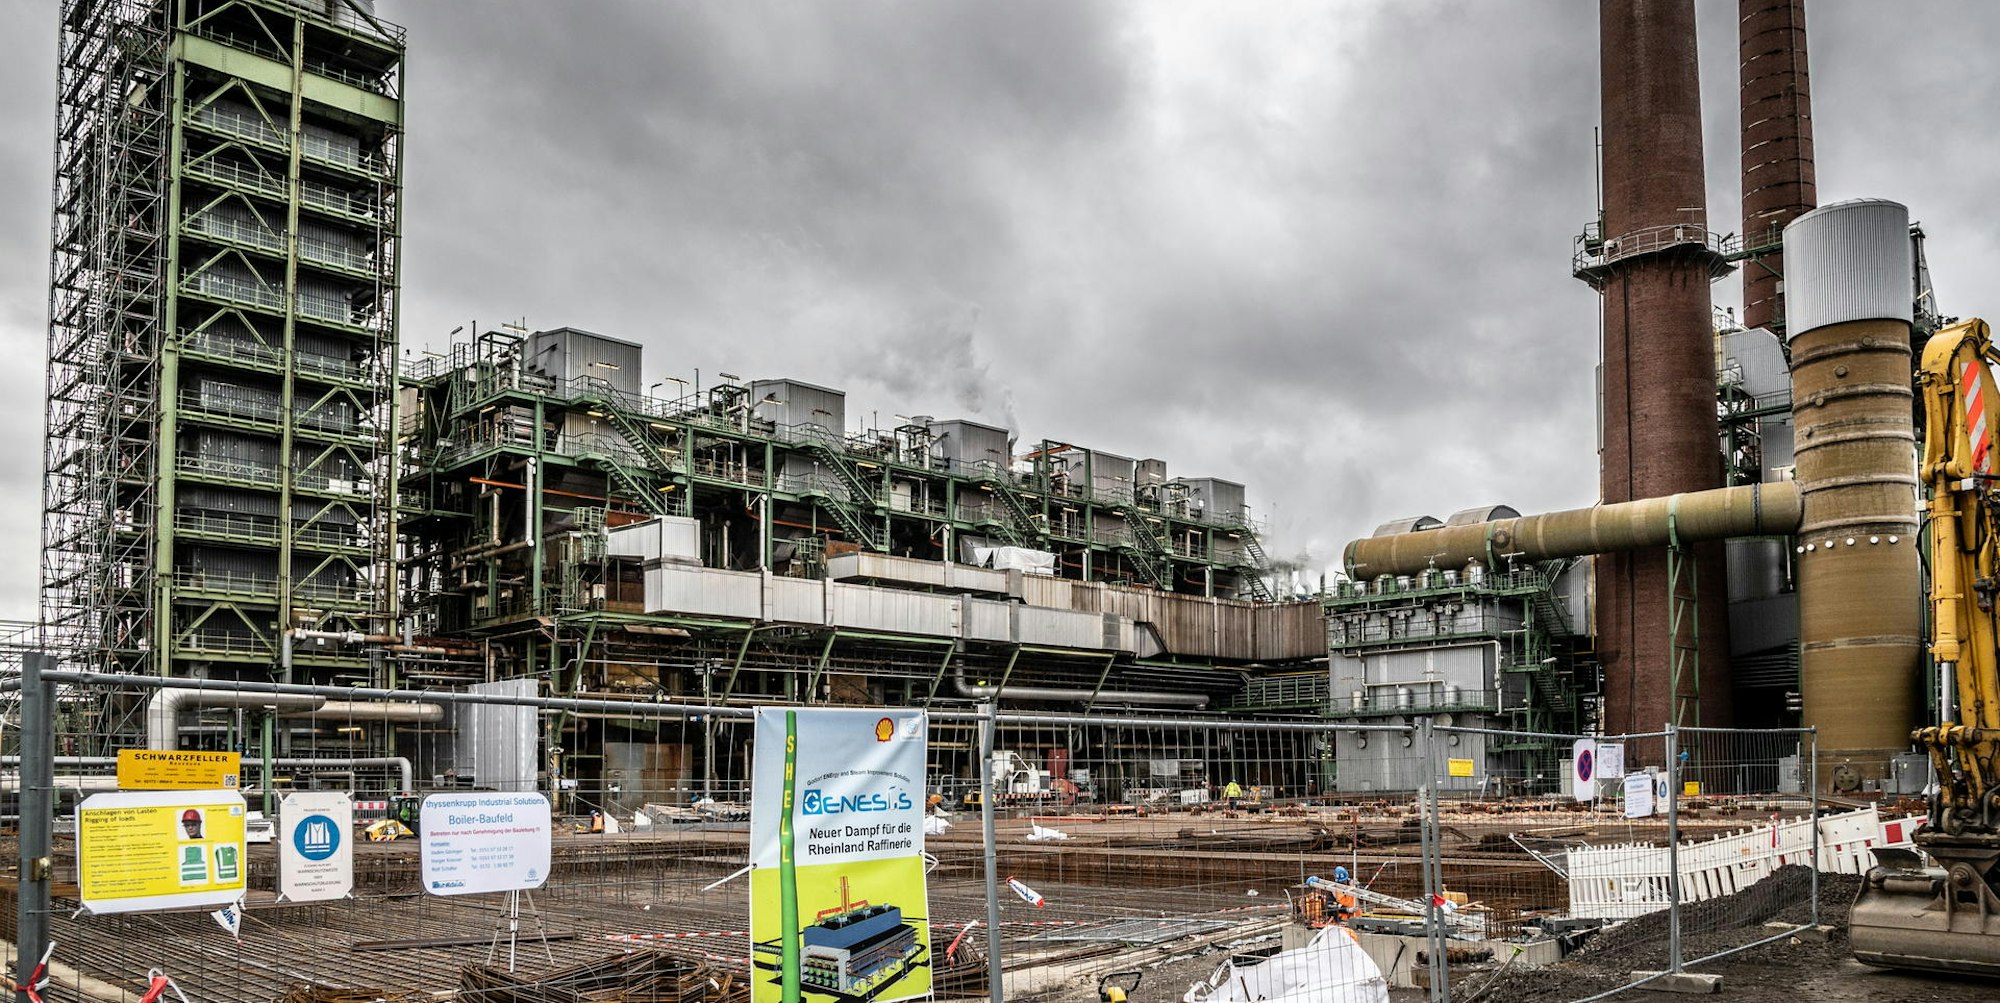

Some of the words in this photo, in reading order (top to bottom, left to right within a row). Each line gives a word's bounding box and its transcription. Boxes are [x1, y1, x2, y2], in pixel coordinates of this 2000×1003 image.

[134, 753, 228, 762] SCHWARZFELLER
[894, 772, 911, 783] Solution
[426, 800, 477, 809] thyssenkrupp
[478, 798, 512, 806] Industrial
[513, 797, 545, 805] Solutions
[781, 735, 795, 863] SHELL
[803, 787, 912, 814] GENESIS
[448, 813, 513, 825] Boiler-Baufeld
[809, 827, 842, 839] Neuer
[845, 824, 880, 838] Dampf
[882, 823, 896, 834] für
[898, 822, 912, 834] die
[808, 841, 864, 856] Rheinland
[867, 837, 912, 851] Raffinerie
